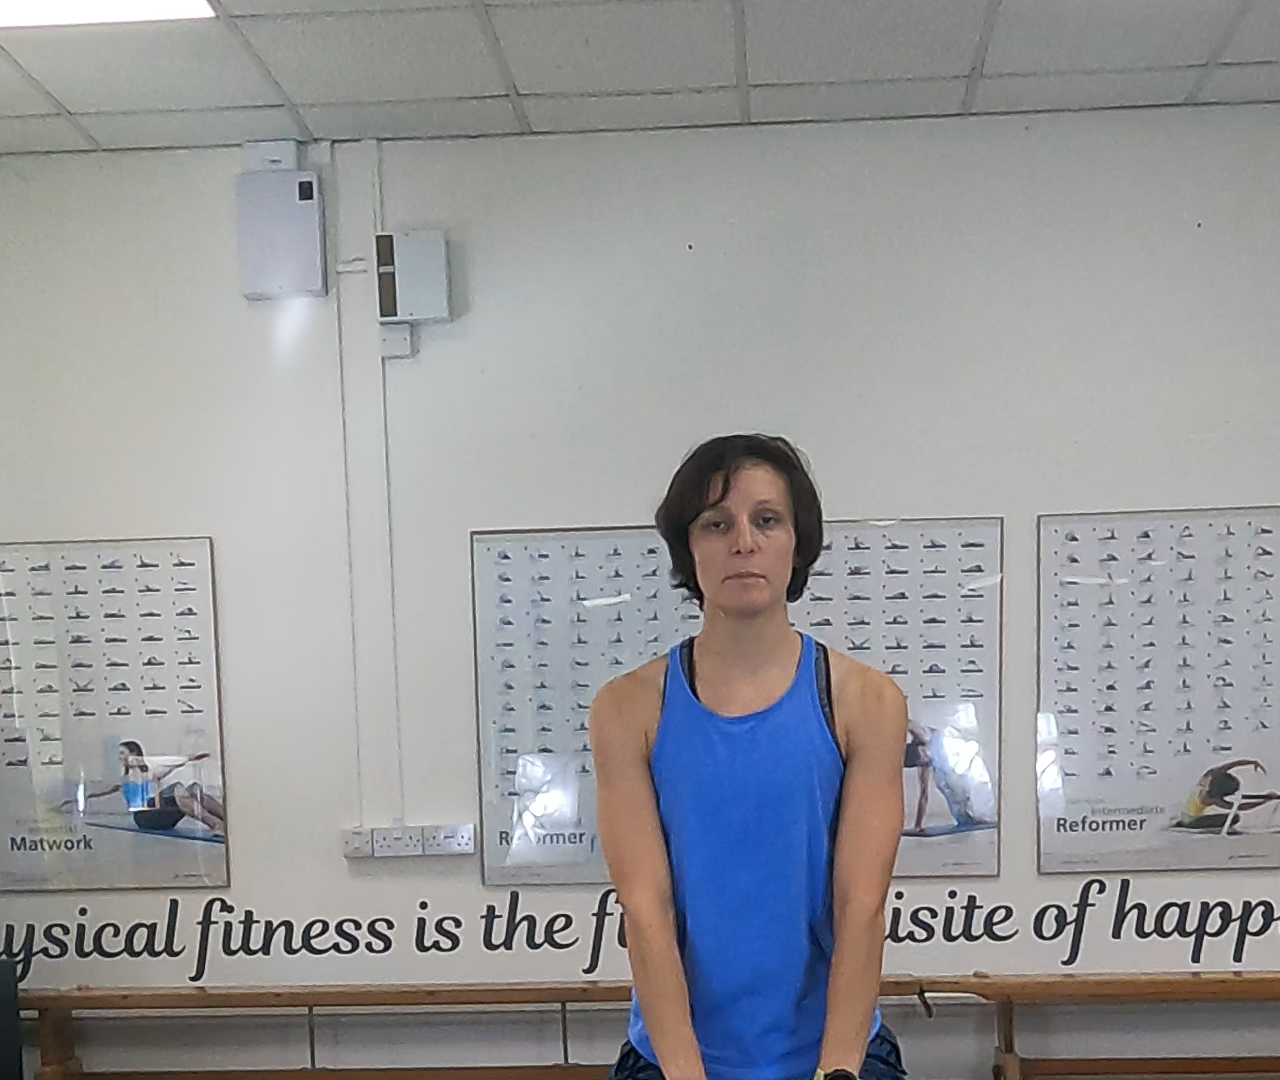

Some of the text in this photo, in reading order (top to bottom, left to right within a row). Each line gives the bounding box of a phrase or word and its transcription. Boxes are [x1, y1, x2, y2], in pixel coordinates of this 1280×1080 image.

[1056, 815, 1147, 833] Reformer
[10, 834, 94, 852] Matwork
[189, 897, 395, 982] fitness
[415, 900, 463, 953] is
[480, 891, 579, 951] the
[1034, 878, 1107, 966] of
